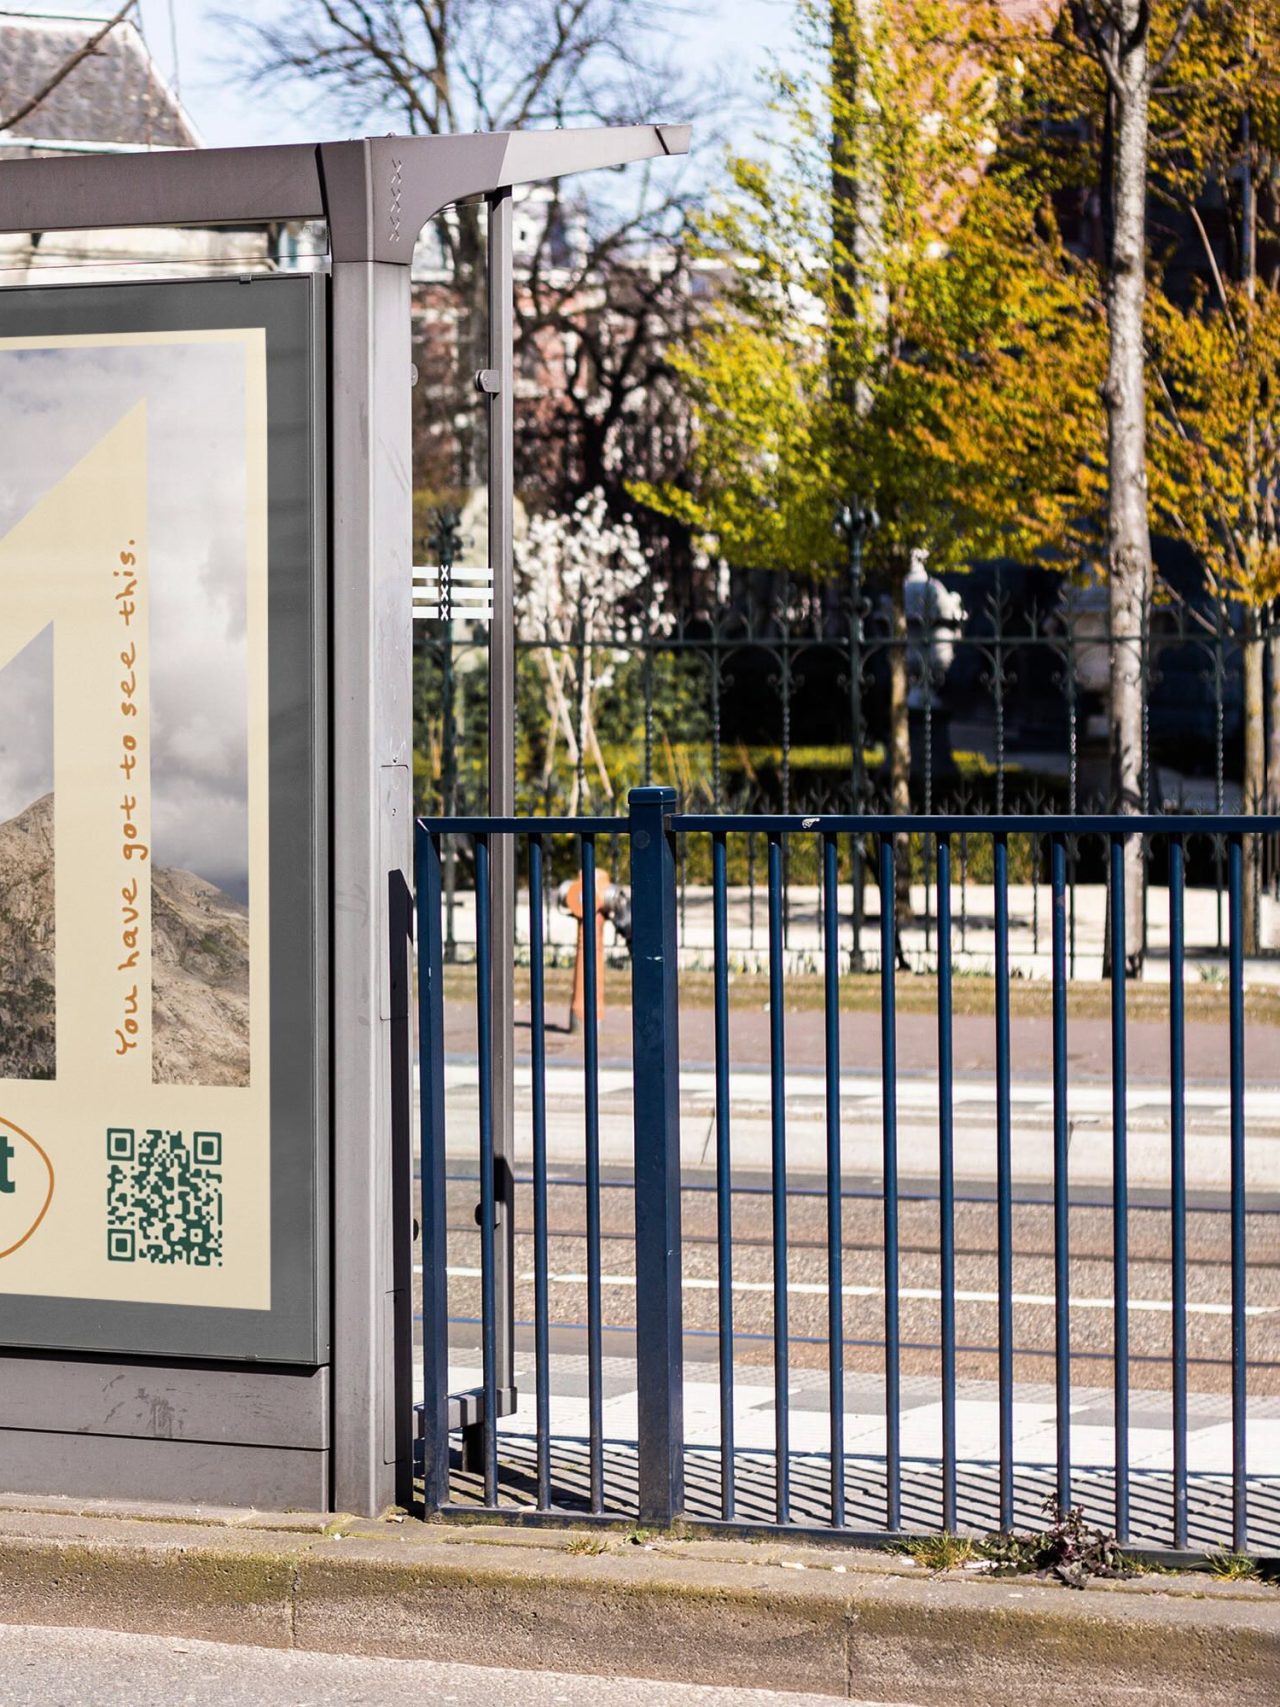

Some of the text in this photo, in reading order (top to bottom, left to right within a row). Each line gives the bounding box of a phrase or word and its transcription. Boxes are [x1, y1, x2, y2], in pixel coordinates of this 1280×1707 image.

[113, 538, 149, 1057] You have got to see this.
